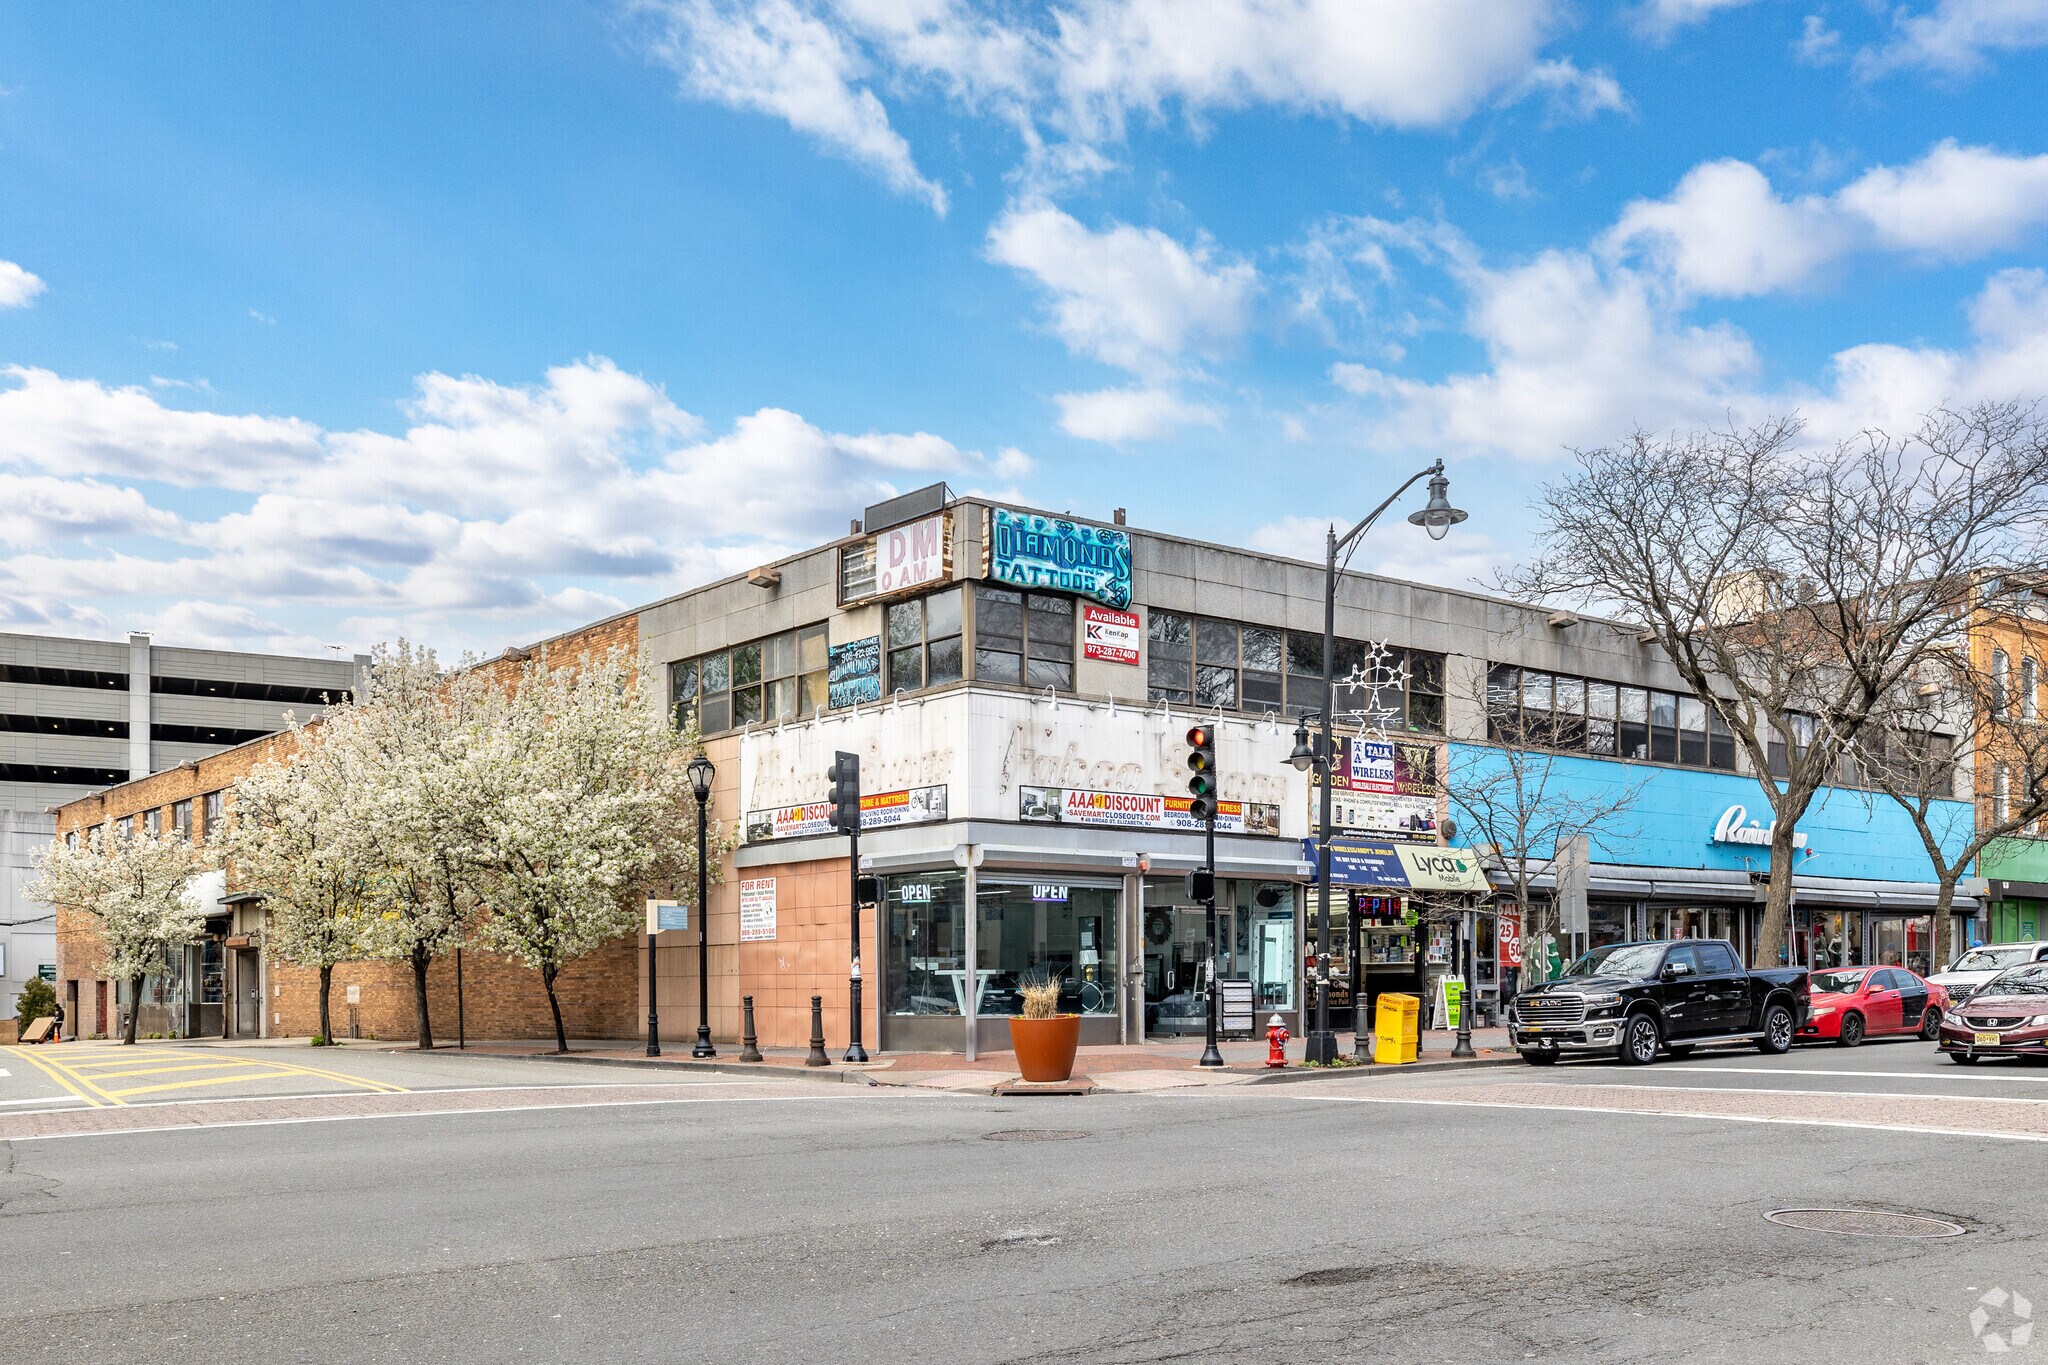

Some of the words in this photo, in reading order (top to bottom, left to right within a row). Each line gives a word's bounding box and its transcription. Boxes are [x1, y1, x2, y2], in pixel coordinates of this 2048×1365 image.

[997, 559, 1096, 592] TATTOOS
[1090, 609, 1136, 626] Available
[1105, 628, 1129, 639] KenKap
[853, 636, 879, 651] ENTRANCE
[1087, 644, 1136, 660] 973-287-7400
[1366, 745, 1391, 758] TALK
[1353, 766, 1394, 781] WIRELESS
[776, 808, 795, 825] AAA
[874, 799, 880, 807] &
[881, 793, 909, 806] MATTRESS
[1068, 791, 1095, 809] AAA
[1104, 795, 1161, 813] DISCOUNT
[1217, 803, 1241, 813] TTRESS
[1069, 808, 1161, 822] SAVEMARTCLOSEOUTS.COM
[1092, 817, 1109, 825] BROAD
[1411, 852, 1457, 876] Lyca
[741, 881, 755, 891] FOR
[756, 879, 775, 890] RENT
[1438, 874, 1461, 883] Mobile
[901, 884, 931, 900] OPEN
[1032, 885, 1068, 899] OPEN
[1359, 897, 1401, 916] REPAIR
[1500, 903, 1520, 916] SAL
[1500, 924, 1511, 938] 25
